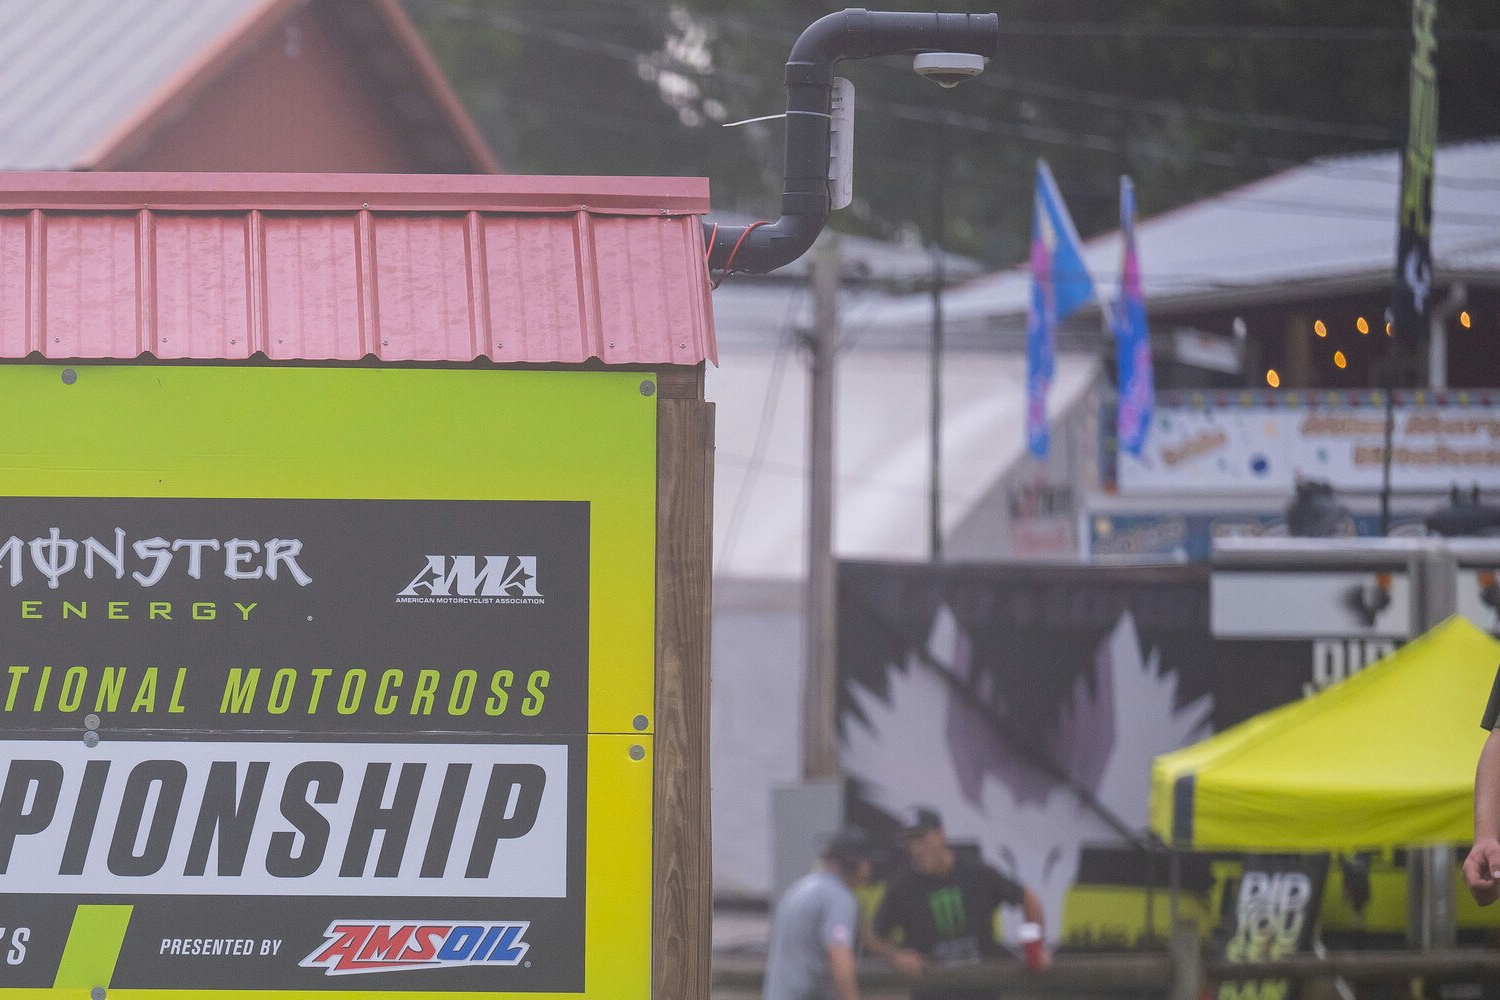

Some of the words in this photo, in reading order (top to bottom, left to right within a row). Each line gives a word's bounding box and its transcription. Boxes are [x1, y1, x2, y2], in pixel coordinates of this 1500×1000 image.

[396, 555, 545, 597] AMA
[21, 601, 259, 621] ENERGY
[436, 597, 493, 605] MOTORCYCLIST
[220, 667, 551, 716] MOTOCROSS
[160, 938, 254, 956] PRESENTED
[260, 938, 283, 956] BY
[310, 922, 528, 971] AMSOIL
